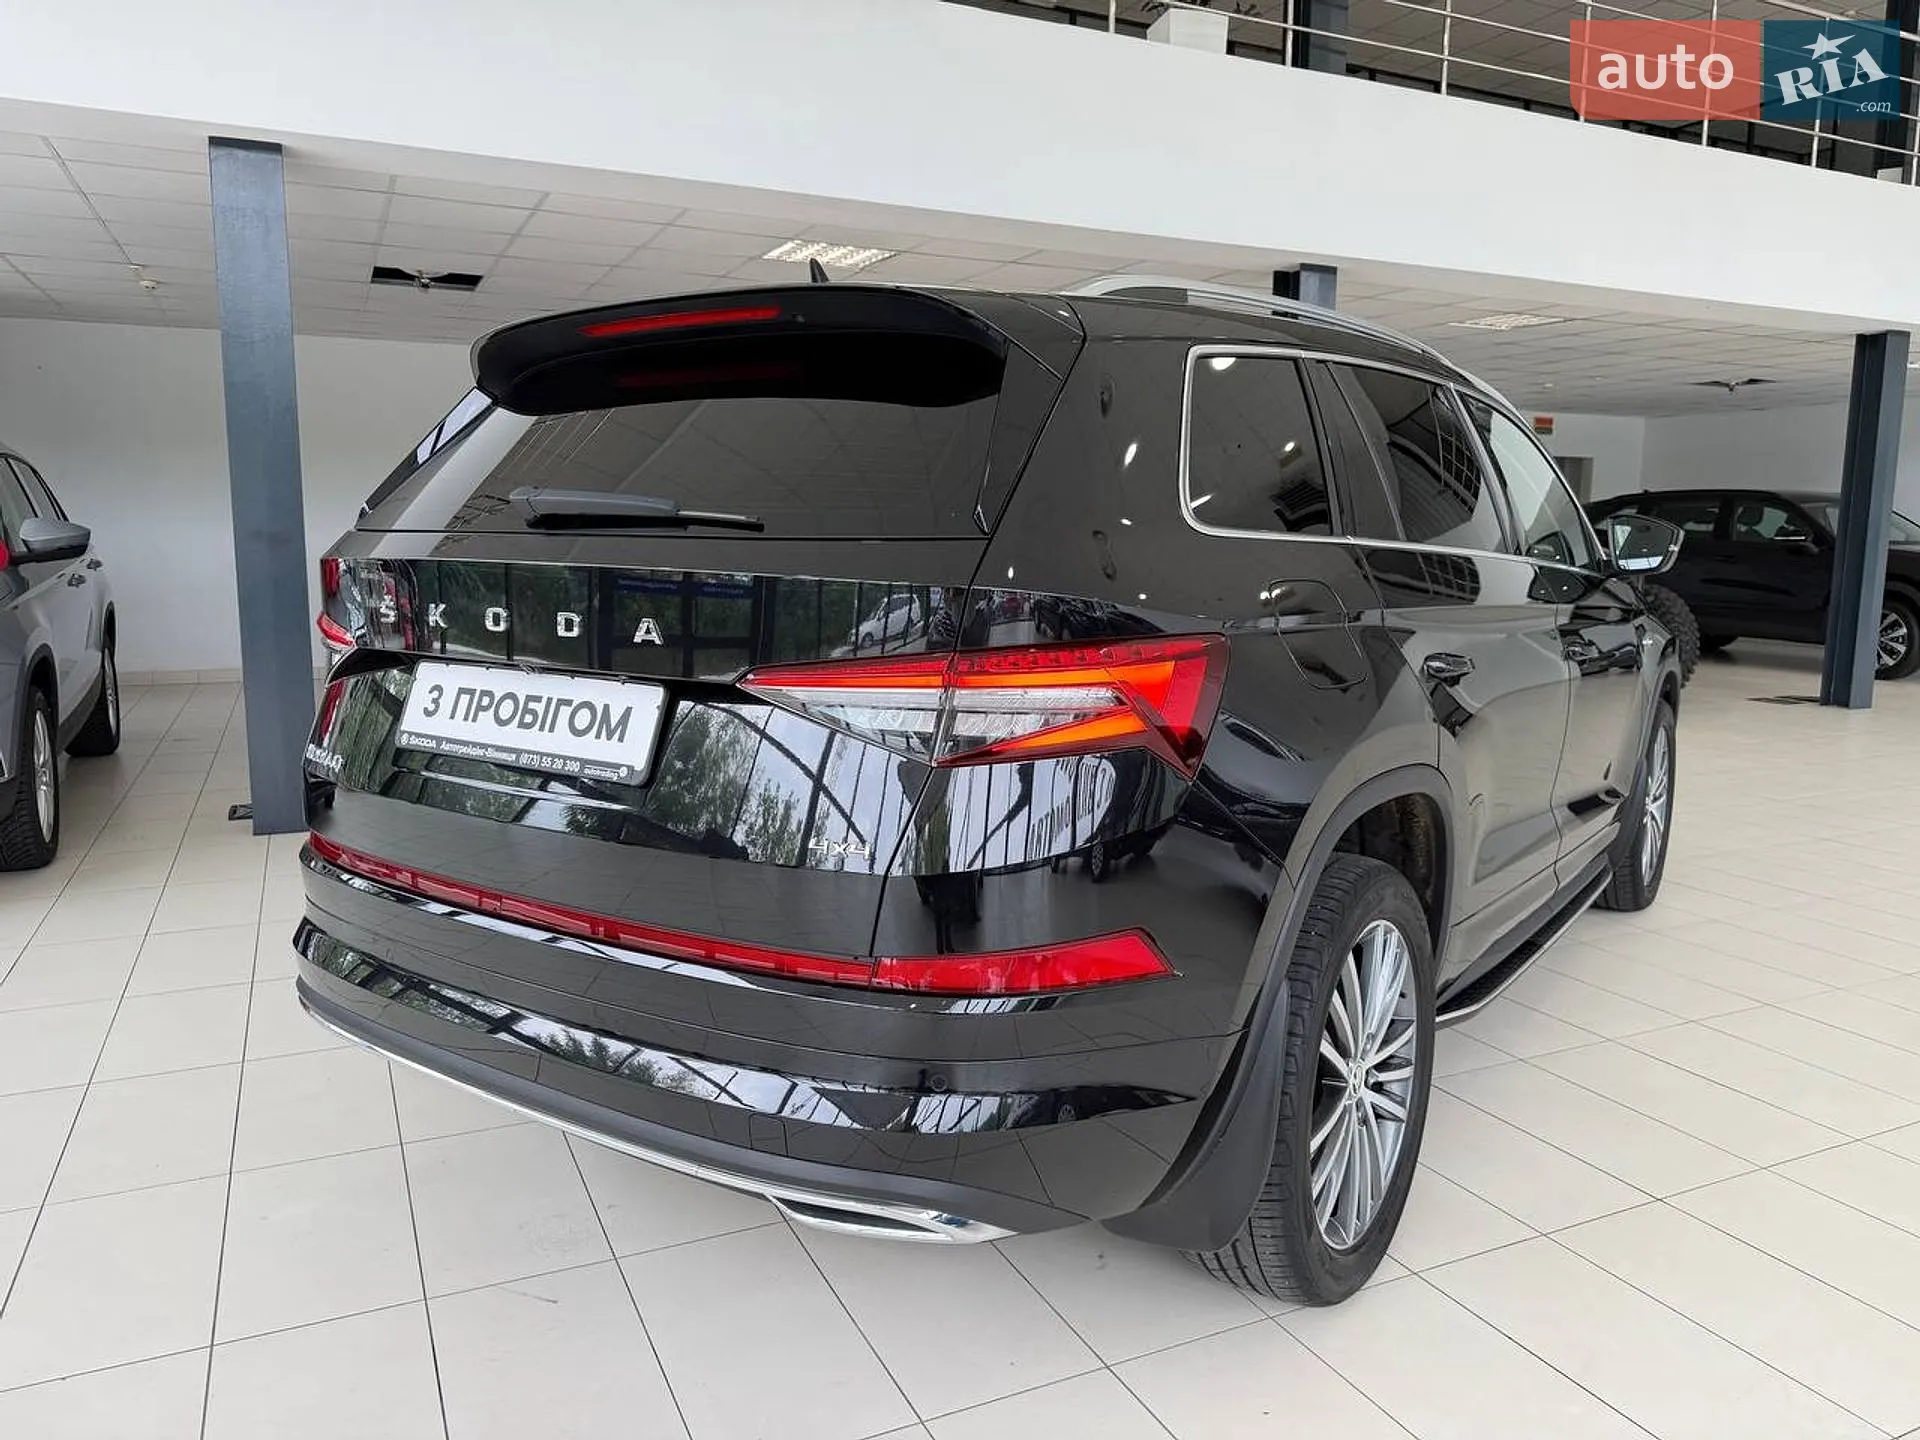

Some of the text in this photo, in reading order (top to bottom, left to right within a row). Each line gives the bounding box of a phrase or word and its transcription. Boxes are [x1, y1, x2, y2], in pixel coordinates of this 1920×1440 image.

[379, 595, 664, 646] ŠKODA
[449, 686, 634, 744] ПРОБІГОМ
[519, 751, 541, 768] (073)
[540, 755, 552, 768] 55
